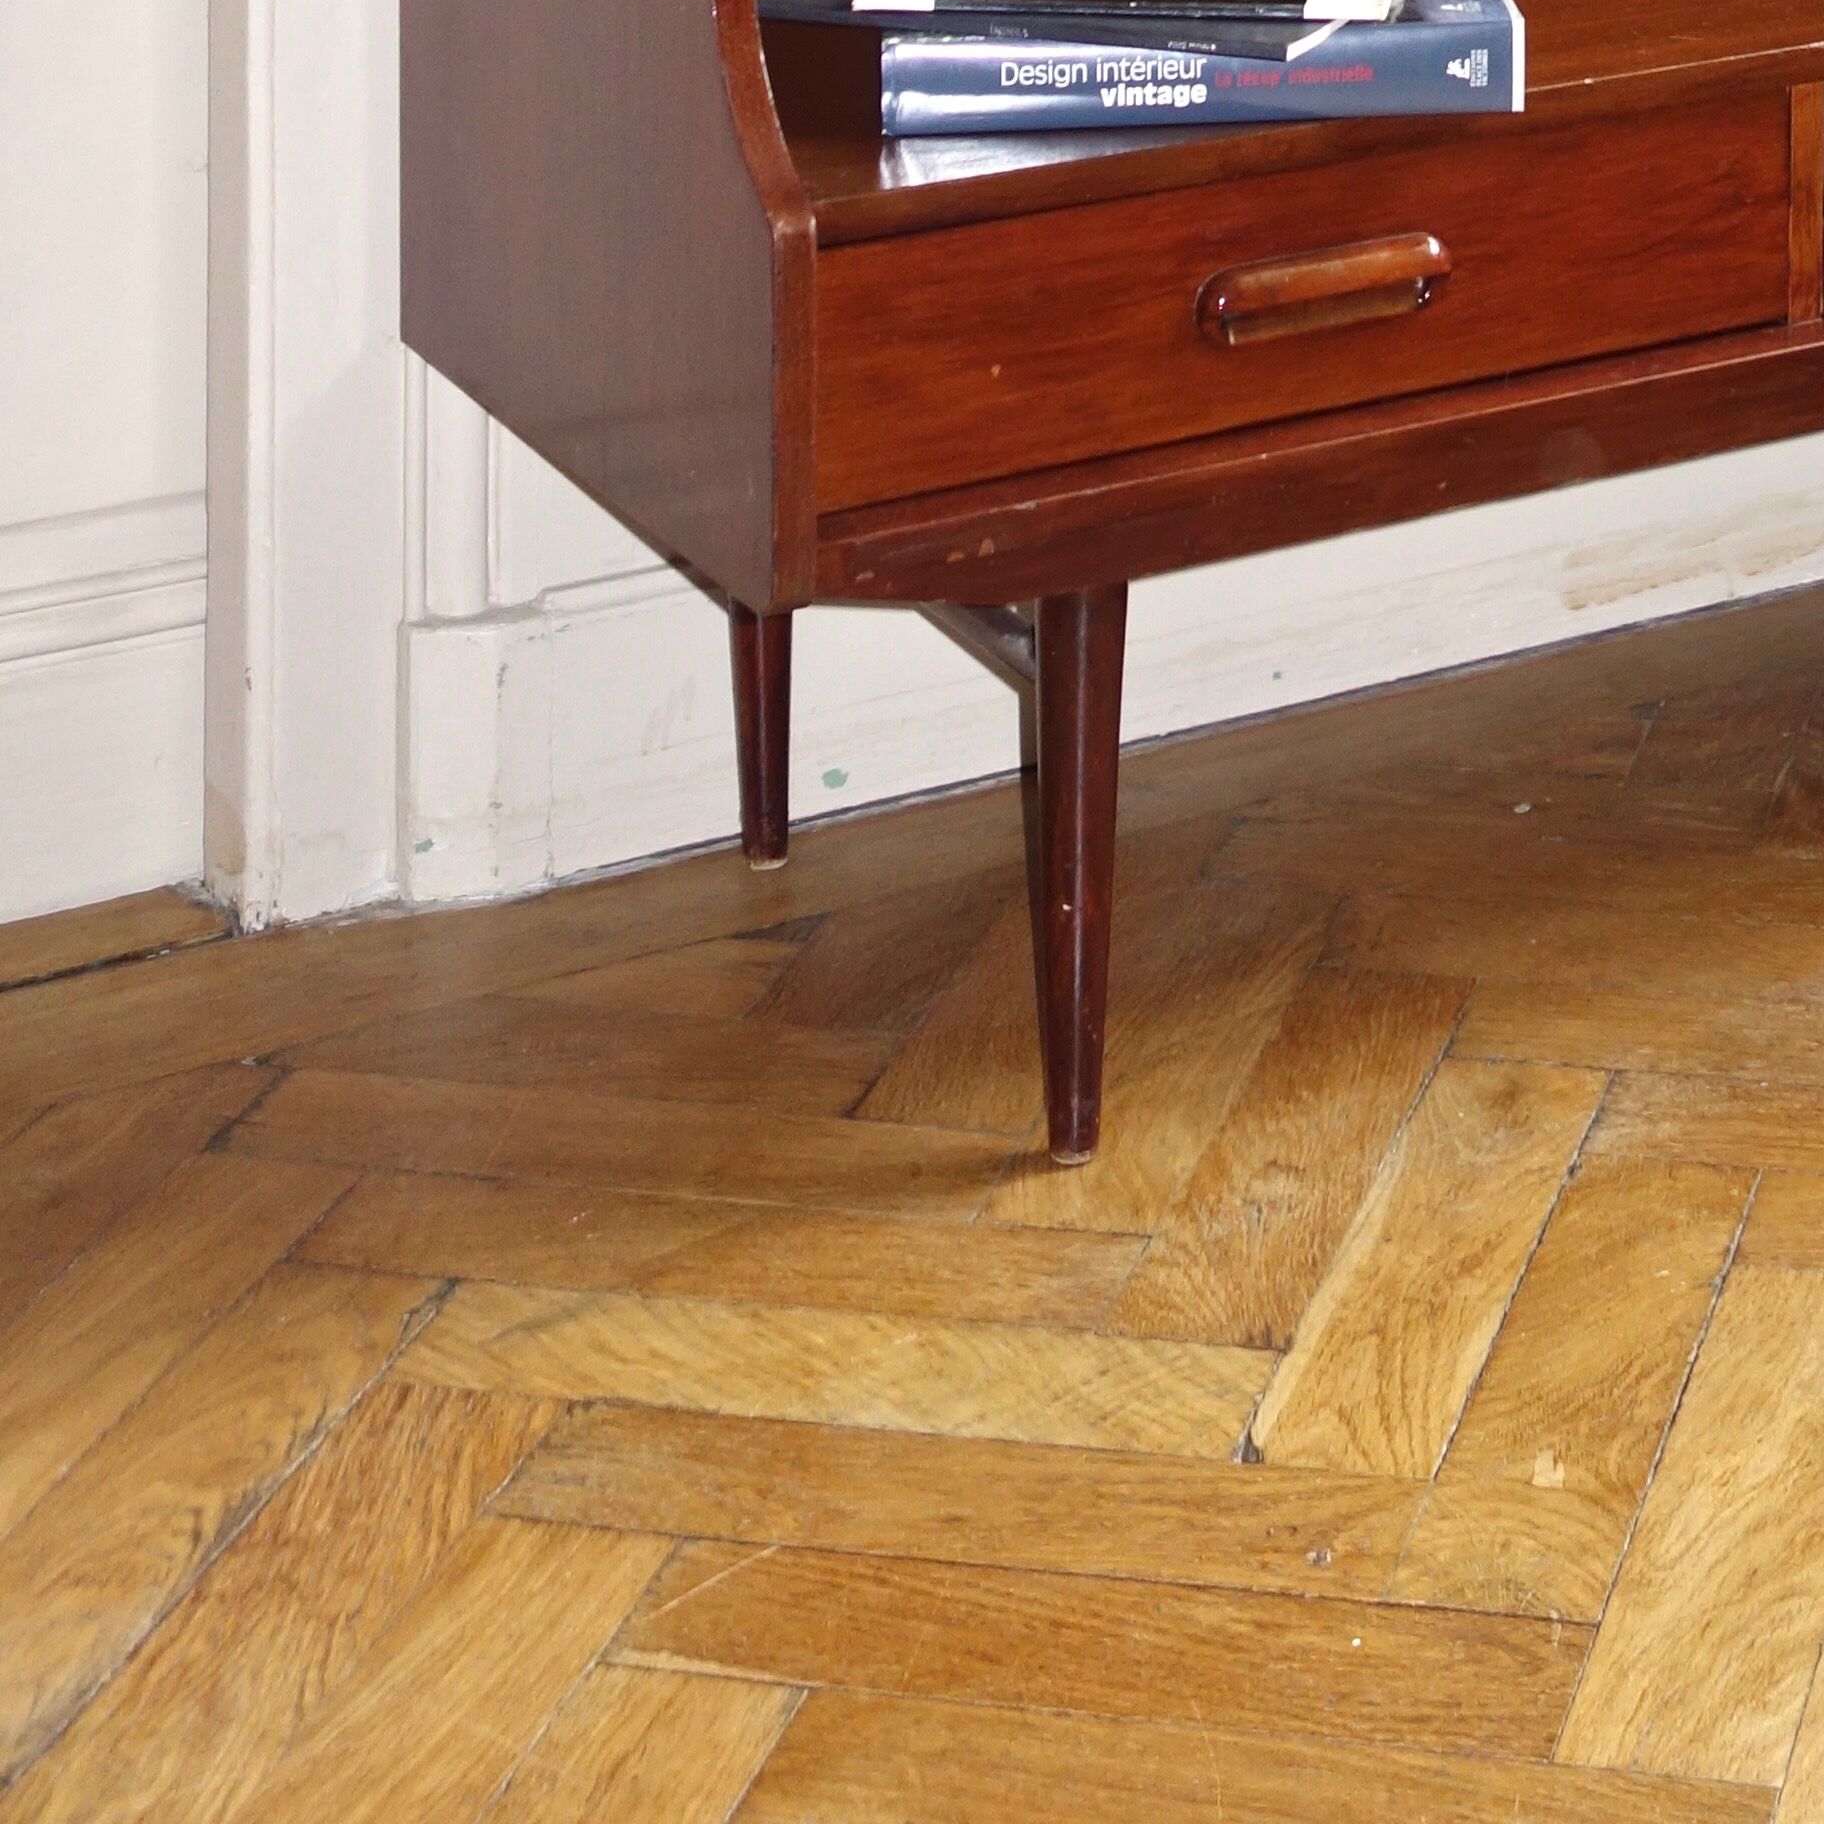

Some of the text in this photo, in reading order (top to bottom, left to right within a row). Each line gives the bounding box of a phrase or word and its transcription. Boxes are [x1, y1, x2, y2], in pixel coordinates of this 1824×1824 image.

[1000, 54, 1208, 88] Design intérieur
[1100, 82, 1208, 108] vintage
